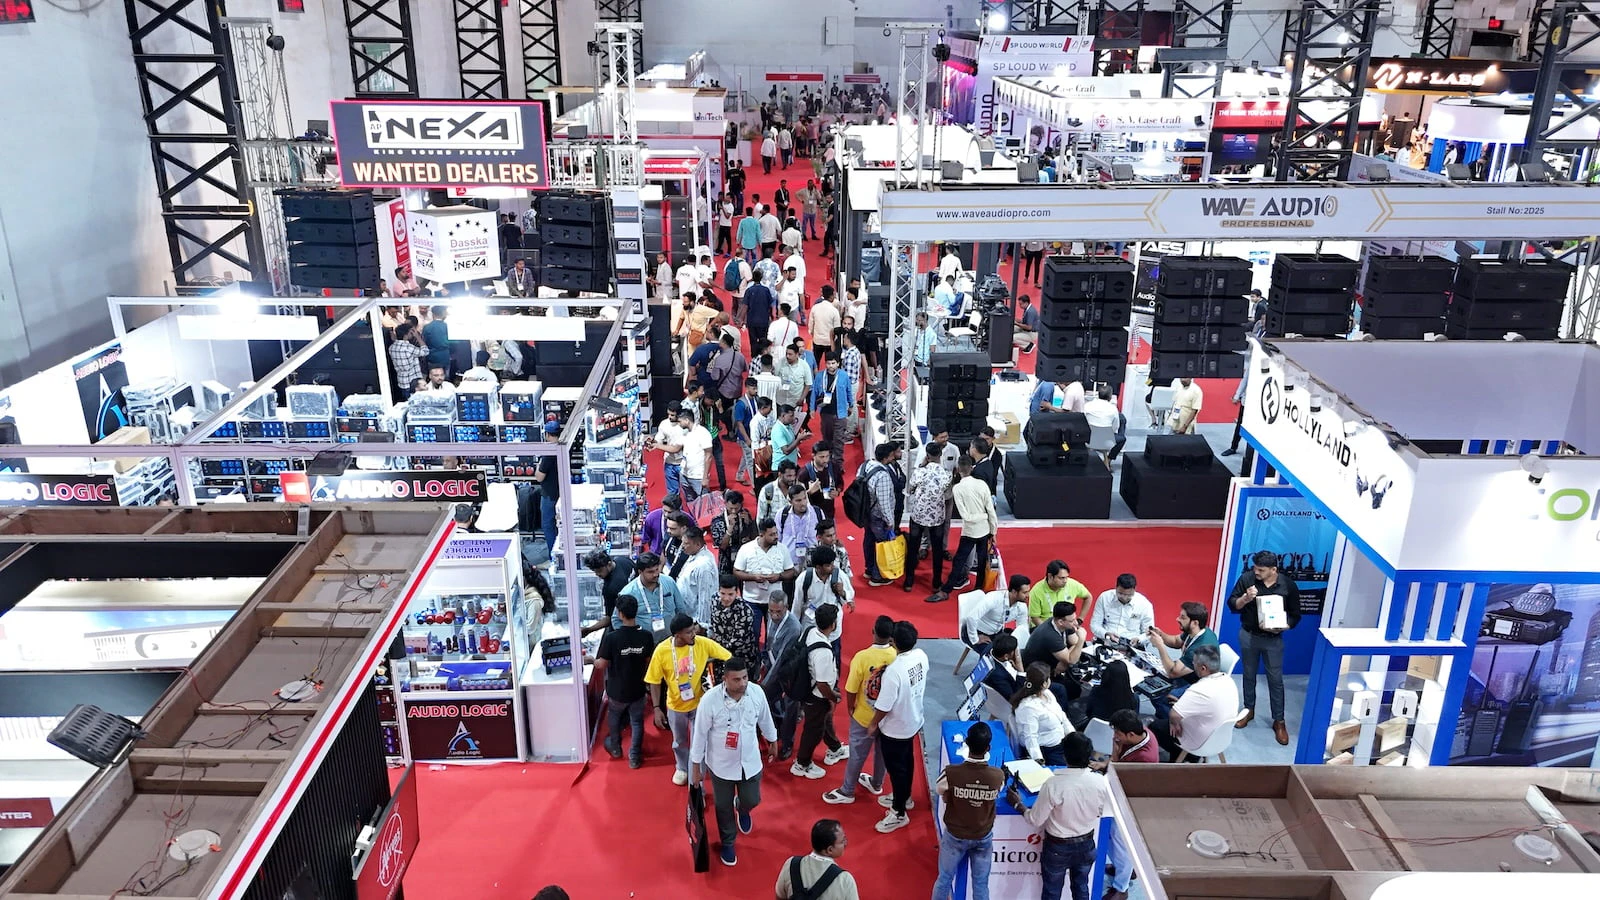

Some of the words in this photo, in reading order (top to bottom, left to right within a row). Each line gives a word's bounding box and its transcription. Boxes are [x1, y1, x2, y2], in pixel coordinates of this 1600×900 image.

[993, 63, 1006, 71] SP
[1008, 63, 1036, 71] LOUD
[386, 111, 510, 140] NEXA
[1160, 115, 1182, 124] Craft
[459, 149, 517, 157] PRODUCT
[352, 162, 441, 183] WANTED
[446, 163, 539, 184] DEALERS
[1201, 197, 1256, 216] WAVE
[1260, 195, 1338, 218] AUDIO
[1486, 206, 1506, 215] Stall
[936, 208, 1051, 220] www.waveaudiopro.com
[1222, 219, 1311, 228] PROFESSIONAL
[457, 256, 486, 270] NEXA
[1136, 292, 1156, 300] Audio
[1283, 398, 1351, 468] HOLLYLAND
[41, 482, 112, 502] LOGIC
[336, 479, 410, 499] AUDIO
[412, 479, 480, 498] LOGIC
[407, 705, 460, 718] AUDIO
[461, 704, 508, 717] LOGIC
[992, 846, 1042, 863] icro
